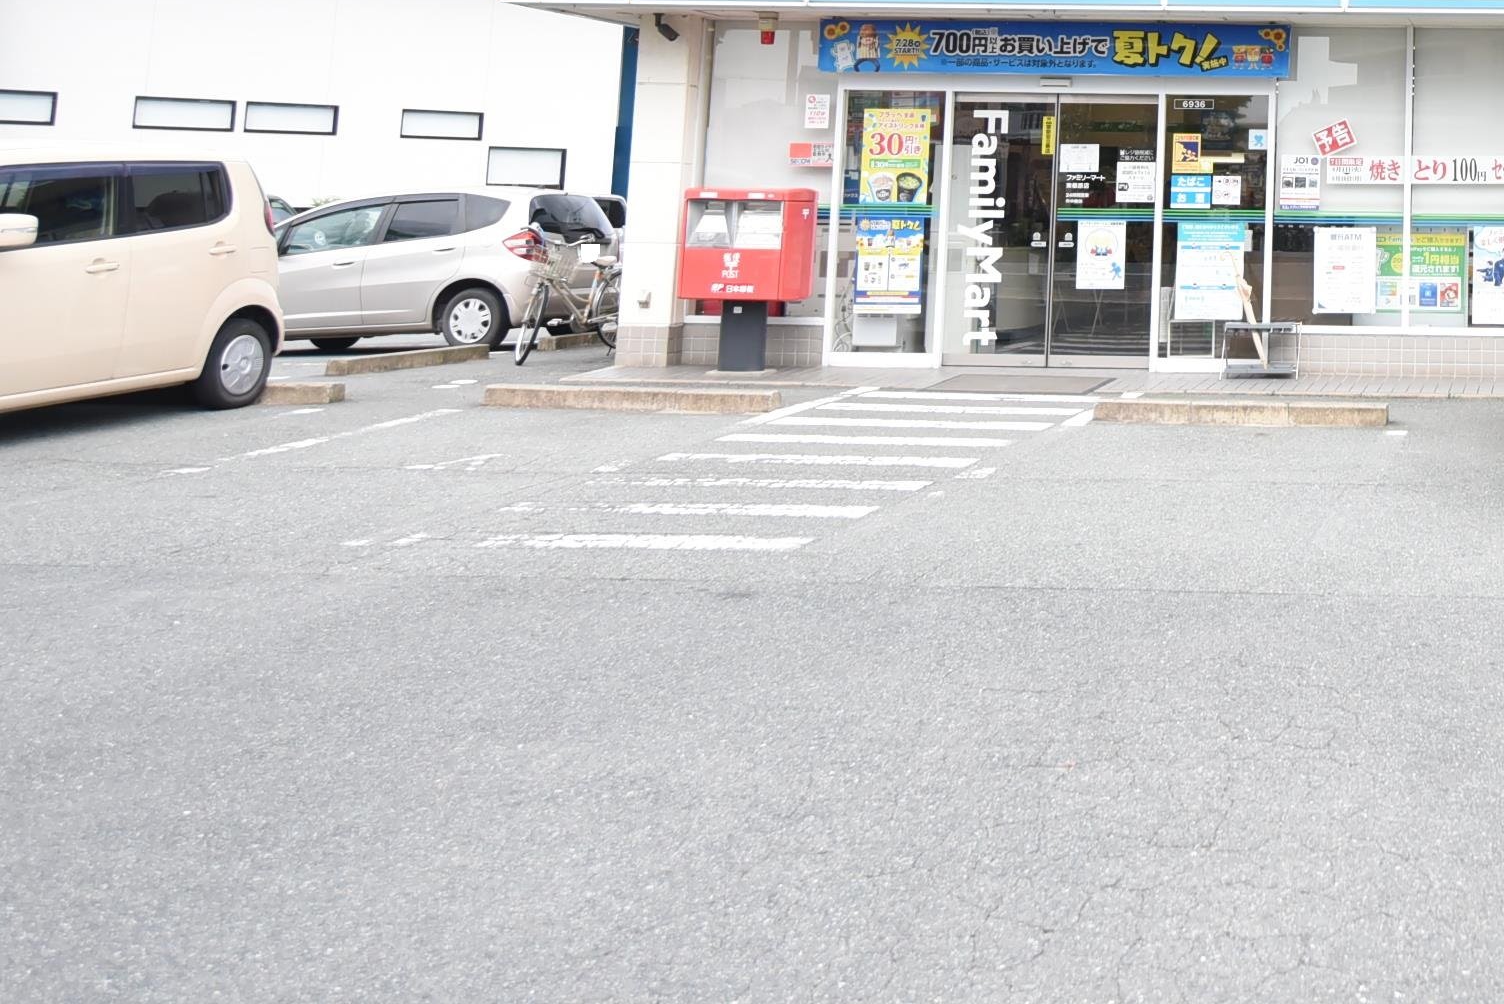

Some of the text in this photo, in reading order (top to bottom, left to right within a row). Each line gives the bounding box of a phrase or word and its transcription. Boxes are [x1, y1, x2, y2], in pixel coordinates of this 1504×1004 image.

[1182, 100, 1206, 109] 6936
[1315, 124, 1351, 153] 予告
[869, 132, 904, 156] 30
[1293, 157, 1309, 165] JO1
[1065, 174, 1106, 182] ファミリーマート
[1177, 176, 1206, 187] たばこ
[957, 109, 1010, 346] FamilyMart
[721, 270, 739, 278] POST
